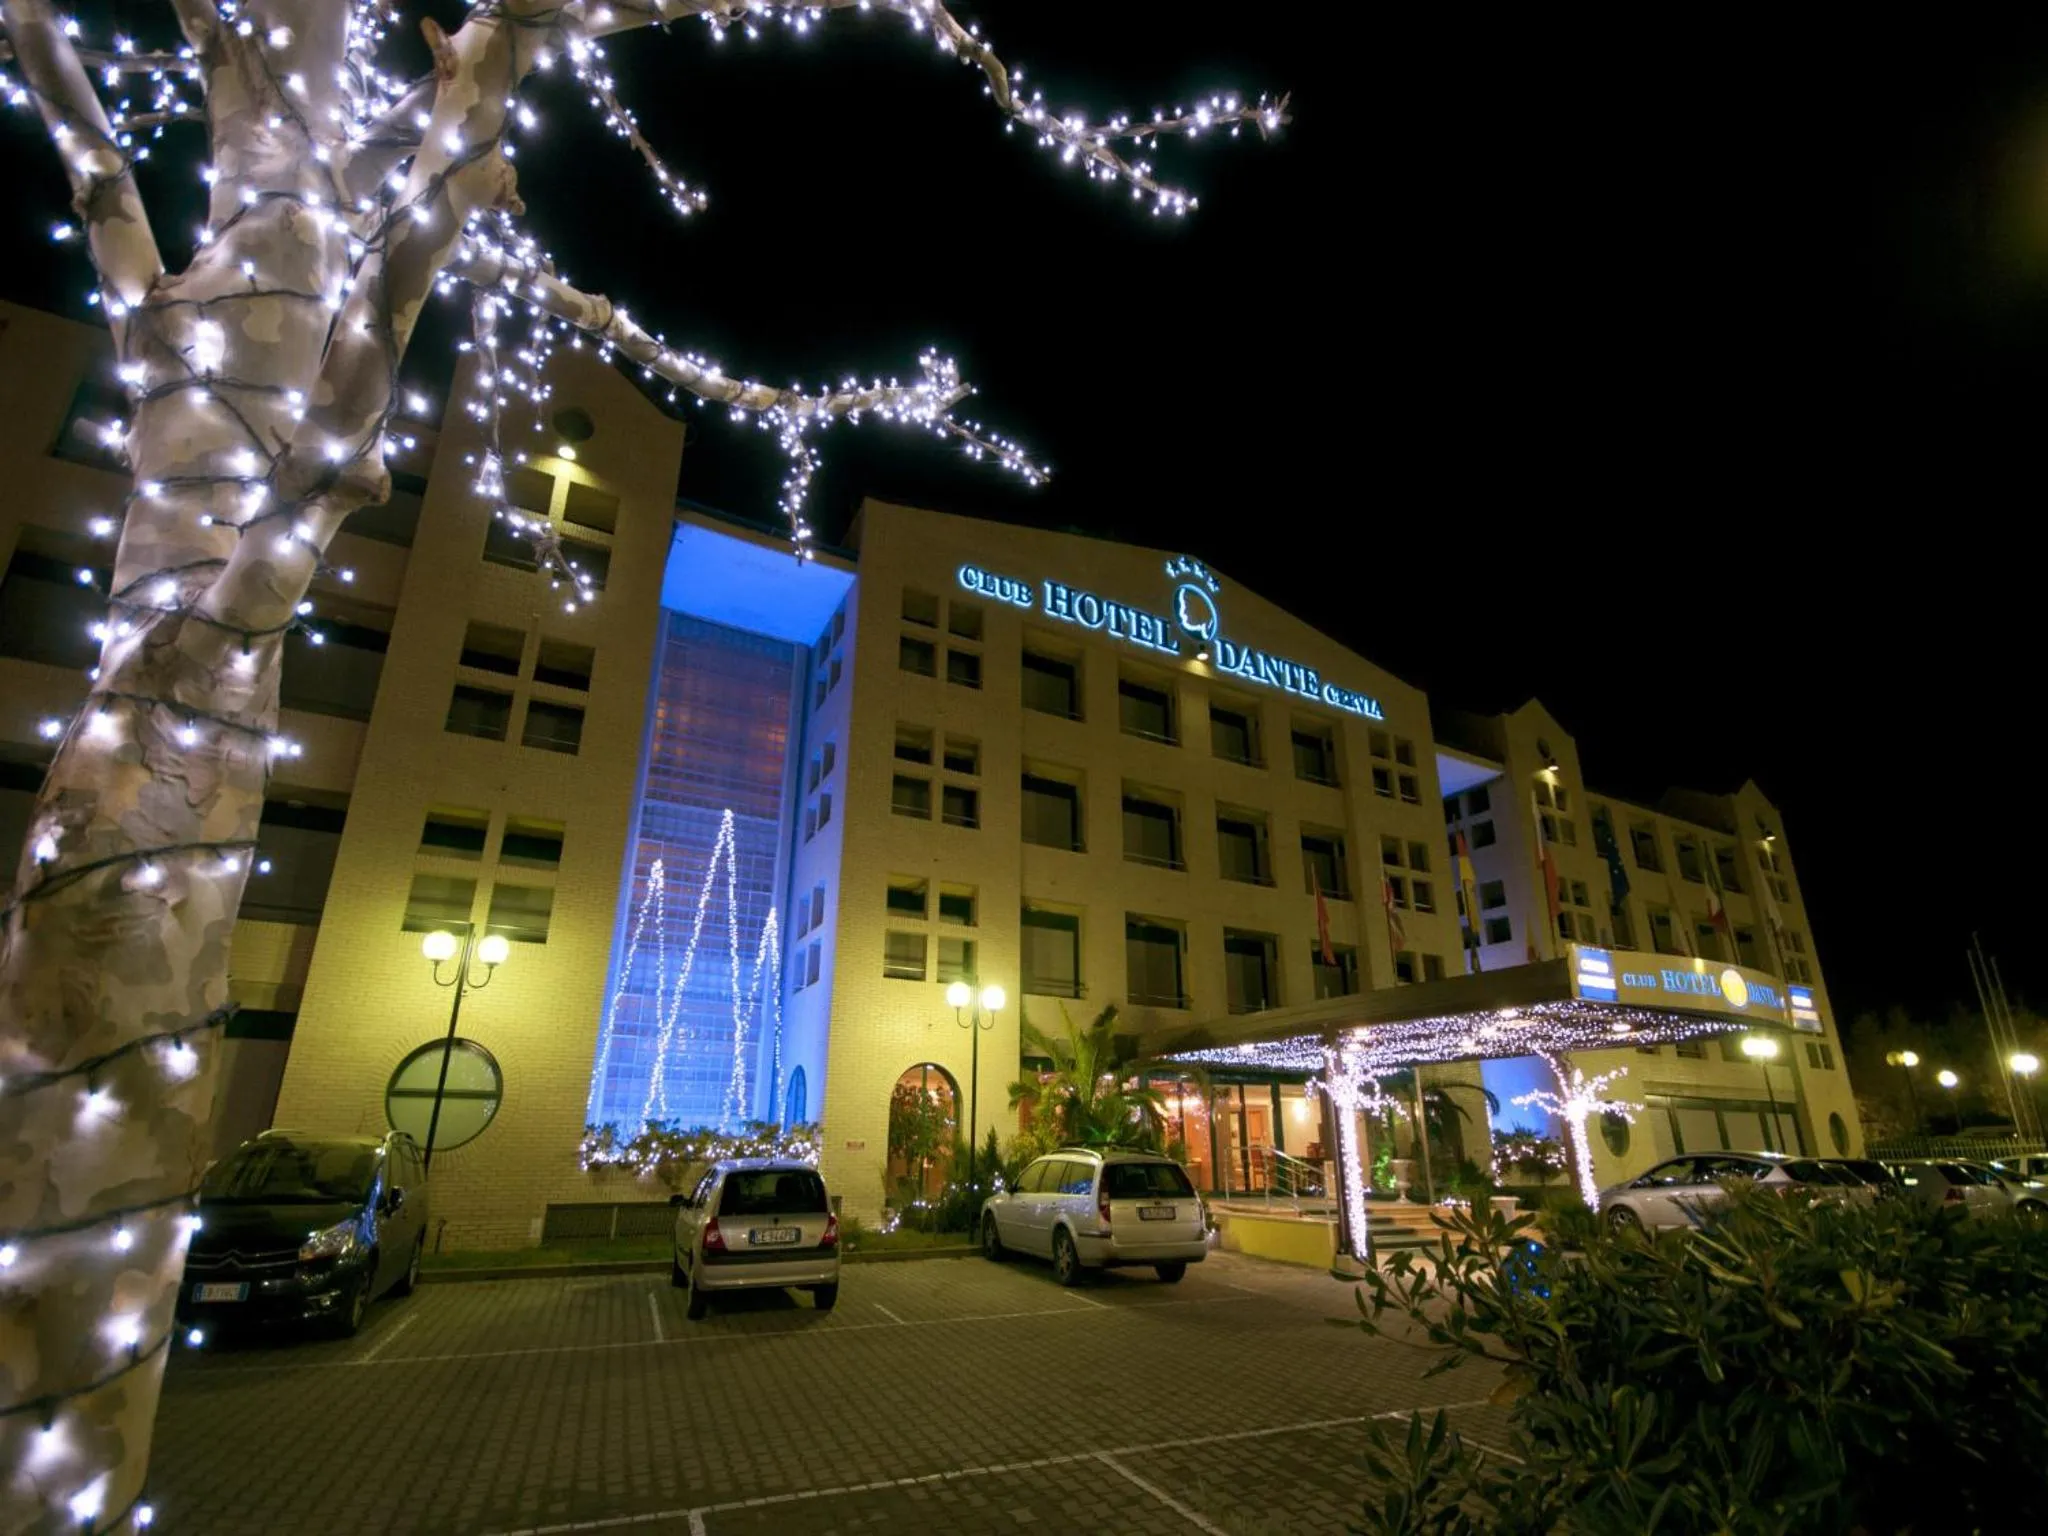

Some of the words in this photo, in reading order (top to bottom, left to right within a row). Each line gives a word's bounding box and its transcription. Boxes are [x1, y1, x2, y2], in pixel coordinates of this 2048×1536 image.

[959, 564, 1032, 607] CLUB
[1043, 579, 1180, 655] HOTEL
[1215, 638, 1320, 699] DANTE
[1622, 971, 1657, 988] CLUB
[1661, 969, 1721, 997] HOTEL
